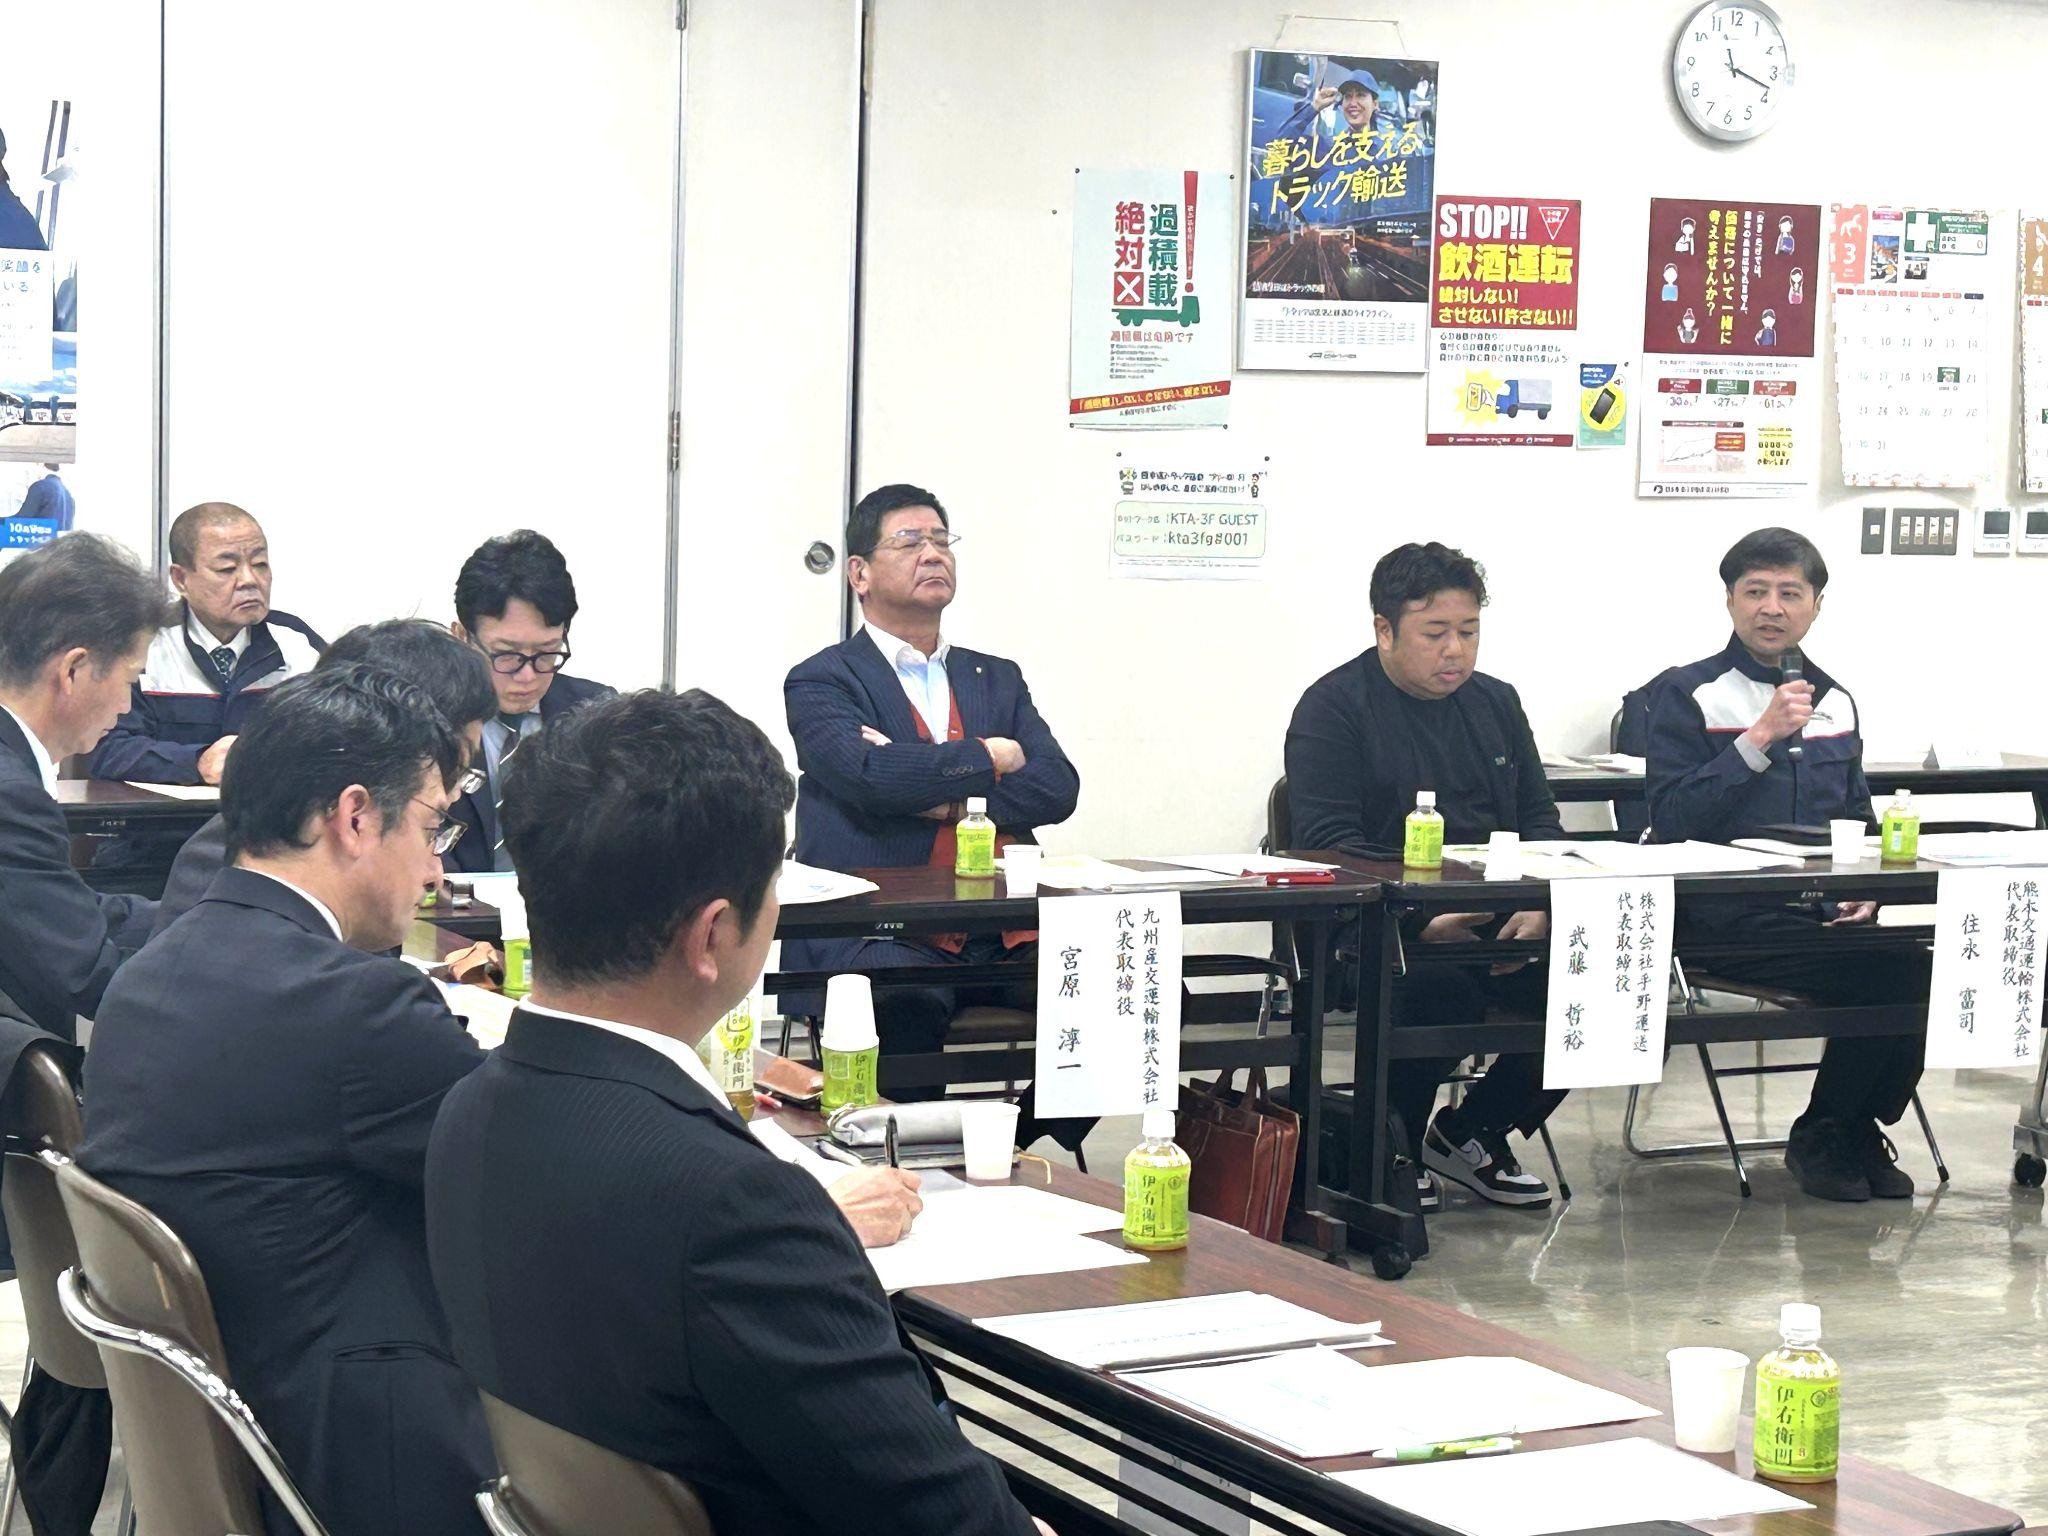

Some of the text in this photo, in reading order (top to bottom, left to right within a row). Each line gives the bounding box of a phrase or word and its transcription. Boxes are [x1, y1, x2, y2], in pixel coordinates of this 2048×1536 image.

[1712, 16, 1722, 31] 11
[1731, 10, 1744, 26] 12
[1754, 21, 1759, 37] 1
[1686, 56, 1696, 71] 9
[1769, 65, 1778, 81] 3
[1691, 82, 1700, 97] 8
[1760, 88, 1768, 103] 4
[1706, 101, 1715, 116] 7
[1723, 110, 1732, 124] 6
[1743, 105, 1752, 120] 5
[1263, 122, 1421, 178] 暮らしを支える
[1271, 160, 1407, 215] トラック輸送
[1114, 201, 1145, 270] 絶対
[1439, 203, 1529, 239] STOP!!
[1148, 203, 1179, 306] 過積載
[1438, 242, 1574, 284] 飲酒運転
[1842, 242, 1856, 265] 3
[2032, 256, 2044, 277] 4
[1219, 514, 1258, 526] GUEST
[1567, 925, 1589, 976] 武藤
[1615, 891, 1634, 993] 代表取締役
[1961, 913, 1981, 960] 住永
[2002, 881, 2022, 986] 代表取締役
[1116, 908, 1135, 1016] 代表取締役
[1057, 945, 1082, 1070] 宮原 淳一
[1142, 907, 1160, 1105] 九州産交運輸株式会社
[1775, 1385, 1796, 1466] 伊右衛門
